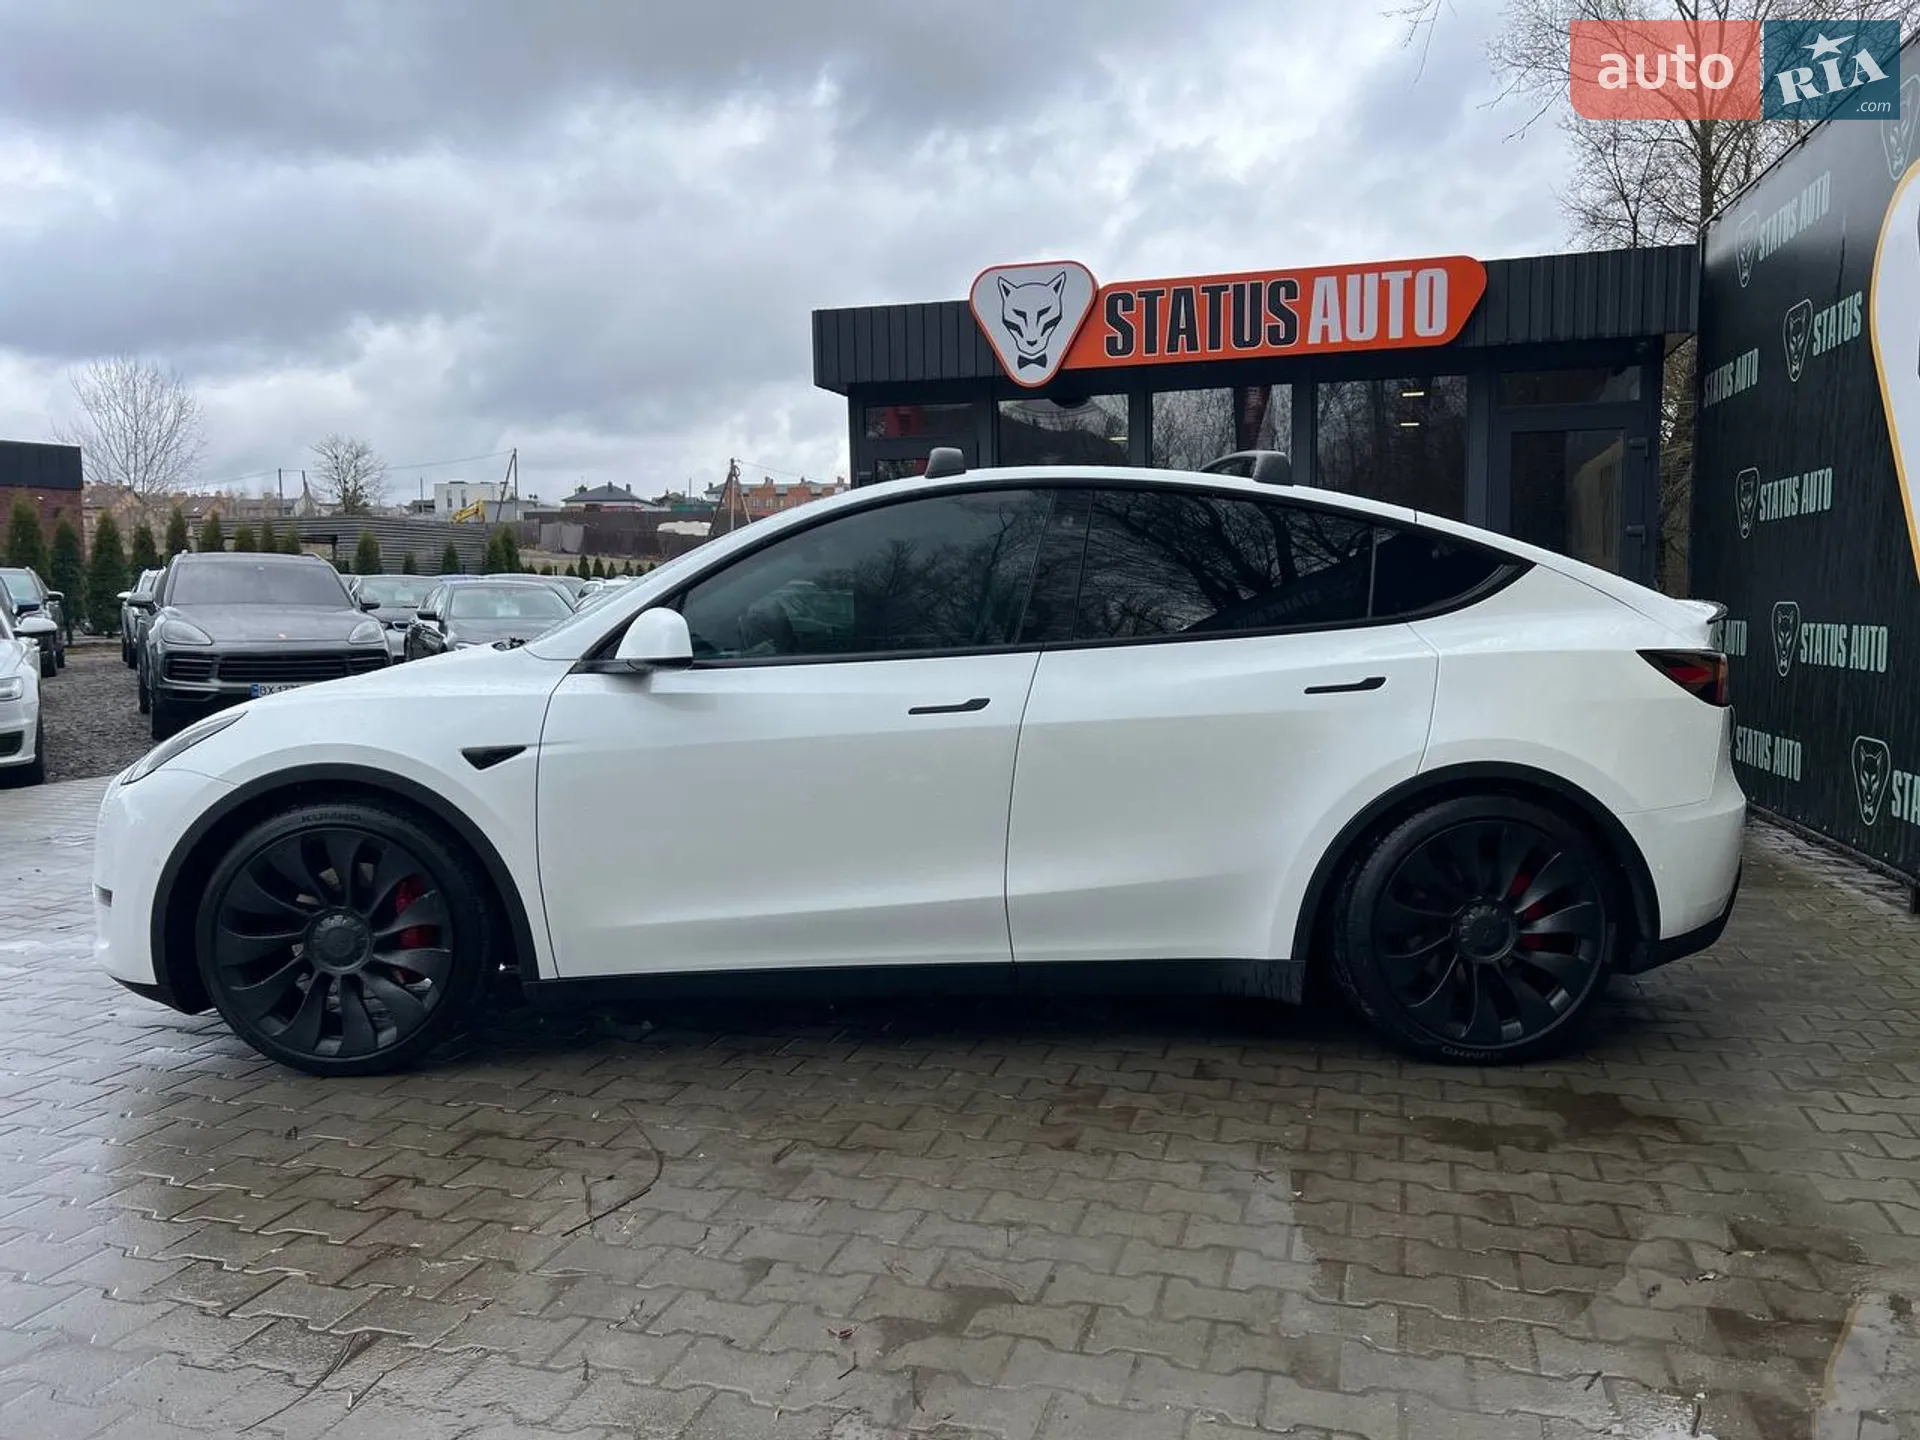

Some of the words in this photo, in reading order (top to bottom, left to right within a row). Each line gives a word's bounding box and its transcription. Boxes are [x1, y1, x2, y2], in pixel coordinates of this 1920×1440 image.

[1759, 196, 1798, 261] STATUS
[1799, 170, 1831, 233] AUTO
[1104, 278, 1299, 359] STATUS
[1307, 267, 1449, 345] AUTO
[1813, 291, 1862, 356] STATUS
[1703, 361, 1734, 408] STATUS
[1734, 348, 1759, 395] AUTO
[1759, 475, 1799, 521] STATUS
[1800, 467, 1833, 515] AUTO
[1723, 619, 1748, 657] AUTO
[1800, 622, 1848, 669] STATUS
[1849, 624, 1888, 674] AUTO
[1735, 725, 1772, 771] STATUS
[1772, 736, 1802, 782] AUTO
